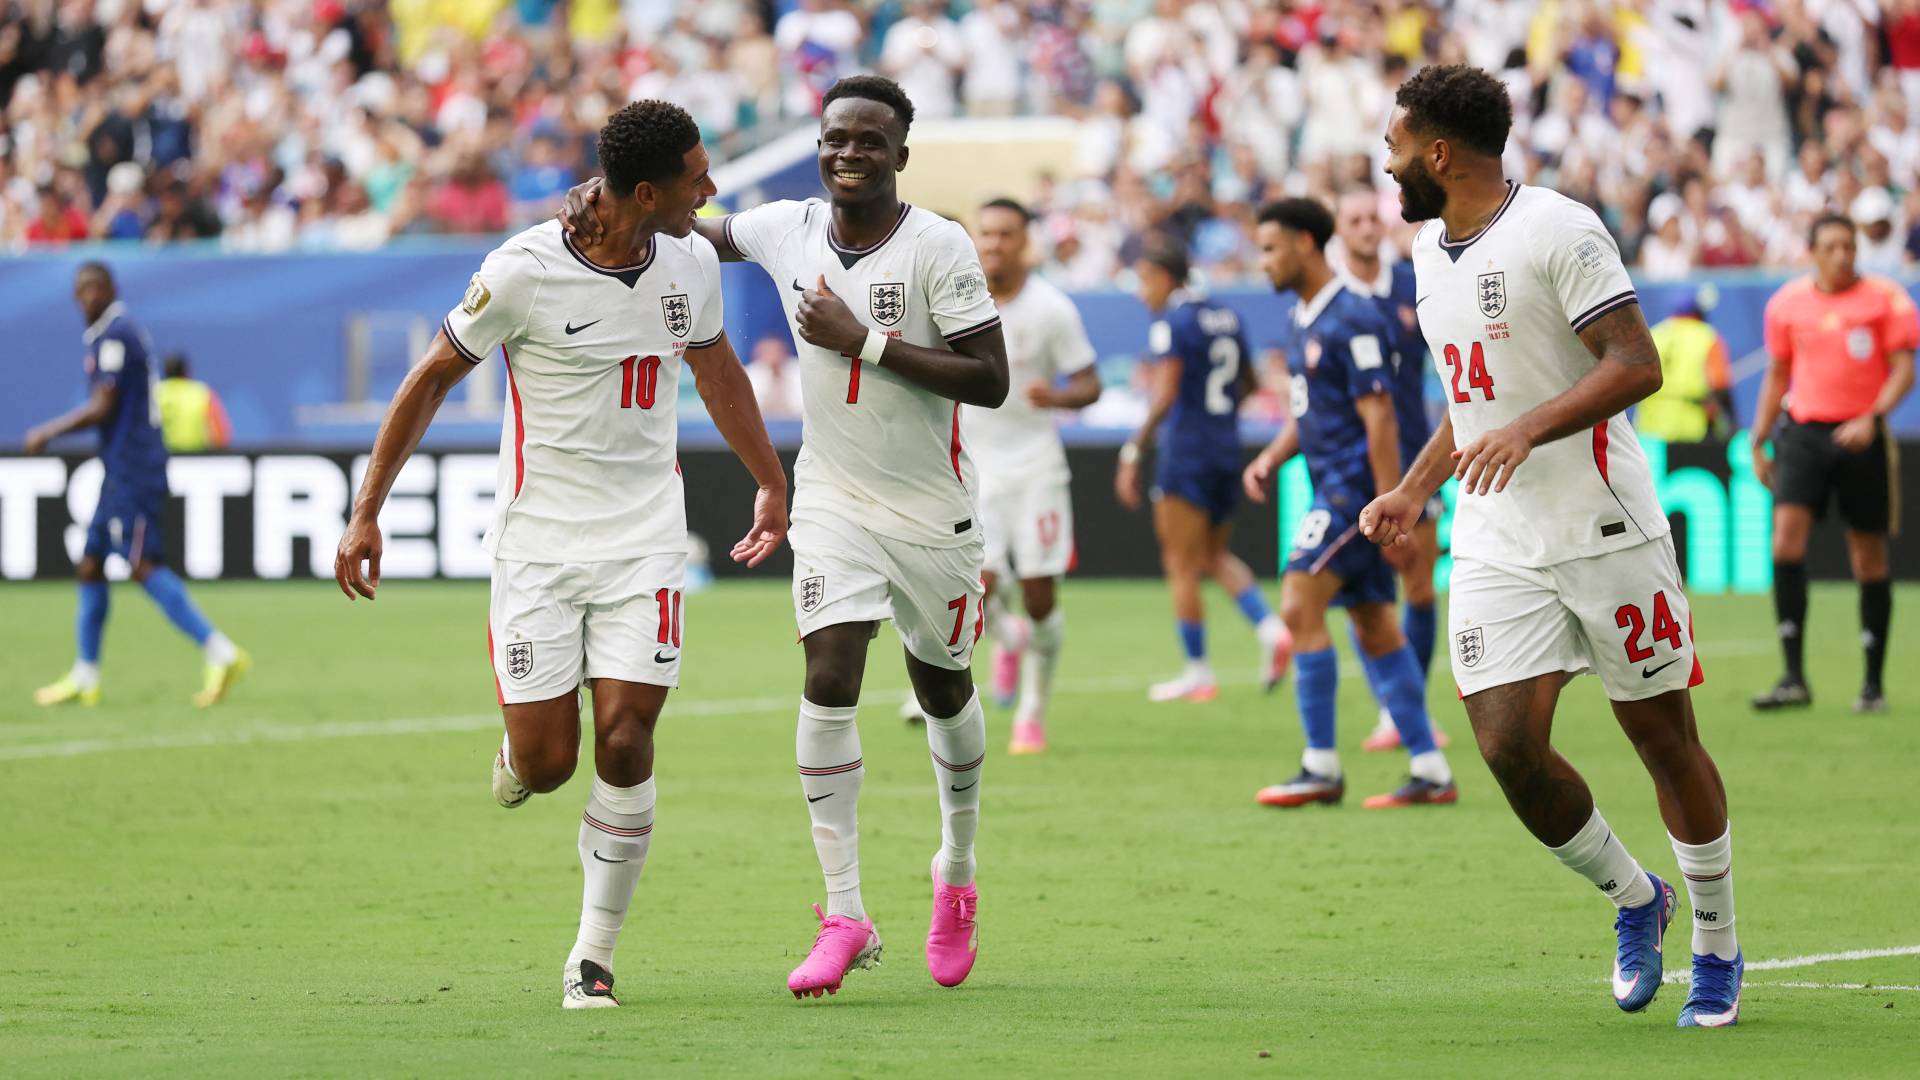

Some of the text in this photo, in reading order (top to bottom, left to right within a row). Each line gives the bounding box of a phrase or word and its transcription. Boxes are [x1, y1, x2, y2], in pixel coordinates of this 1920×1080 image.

[956, 278, 976, 290] UNITES
[1485, 321, 1509, 331] FRANCE
[619, 354, 662, 410] 10
[1205, 336, 1240, 415] 2
[1443, 341, 1496, 404] 24
[946, 592, 967, 647] 7
[1614, 589, 1683, 665] 24
[1694, 908, 1718, 922] ENG
